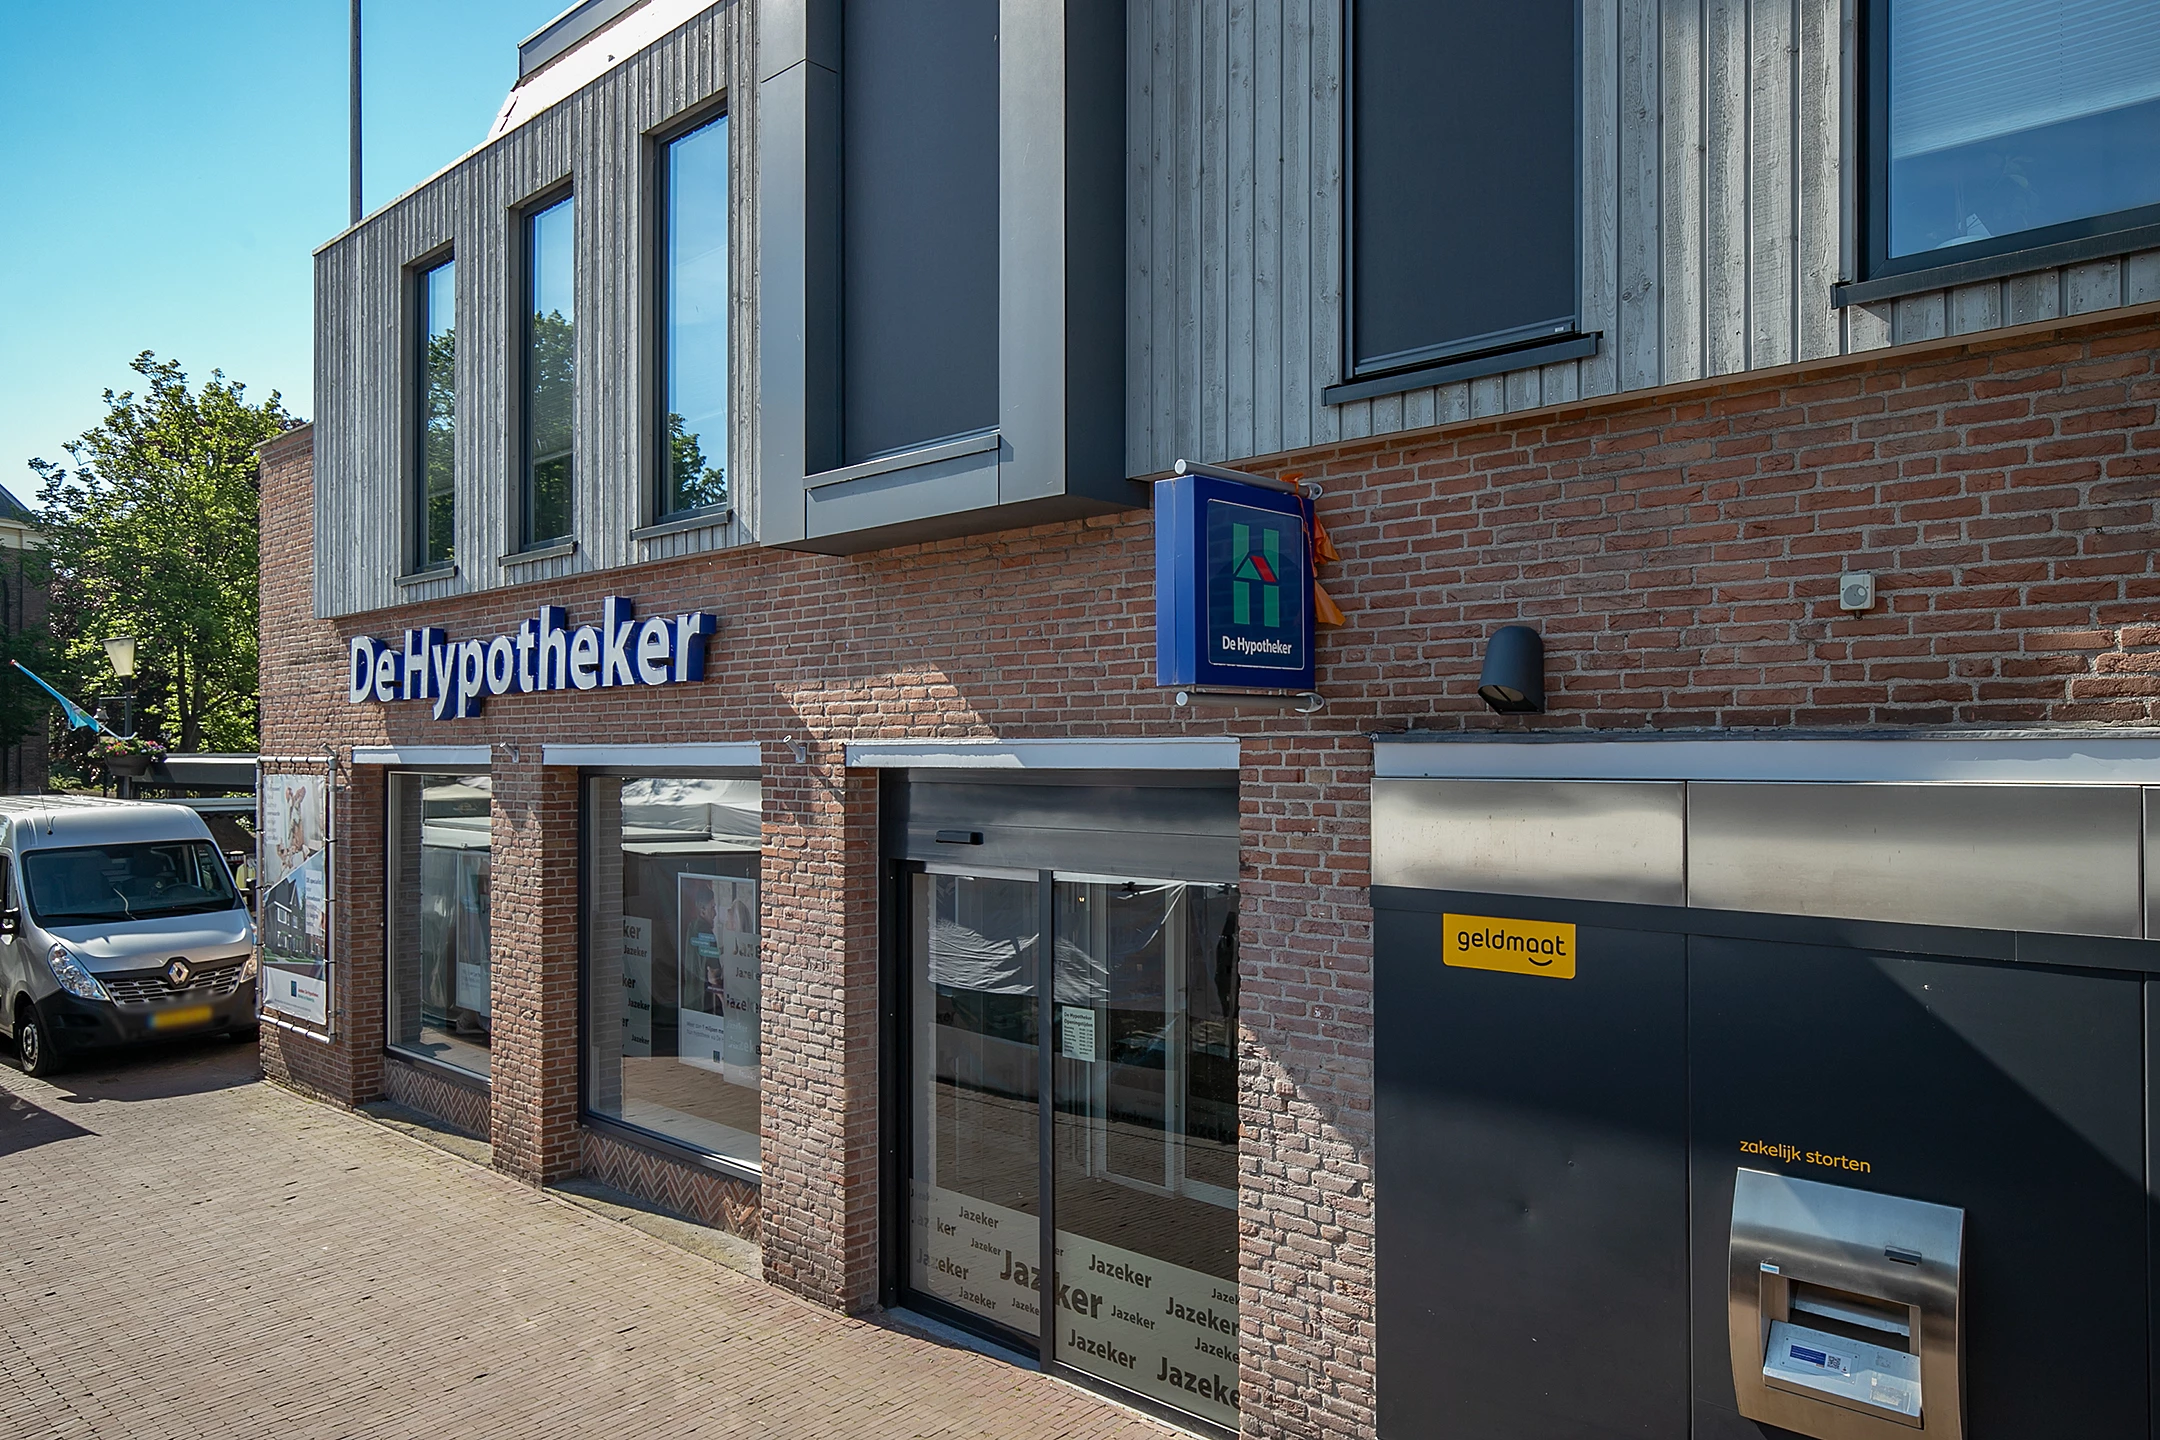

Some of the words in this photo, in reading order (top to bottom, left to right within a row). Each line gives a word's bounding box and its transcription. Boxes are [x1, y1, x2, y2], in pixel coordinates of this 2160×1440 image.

[1222, 635, 1236, 650] De
[1237, 636, 1292, 656] Hypotheker
[350, 635, 398, 703] De
[403, 595, 710, 720] Hypotheker
[623, 945, 648, 958] Jazeker
[1457, 927, 1567, 956] geldmaat
[627, 998, 650, 1011] Jazeker
[631, 1034, 650, 1045] Jazeker
[1740, 1139, 1801, 1163] zakelijk
[1806, 1150, 1871, 1173] storten
[958, 1206, 999, 1229] Jazeker
[970, 1237, 1002, 1257] Jazeker
[1088, 1254, 1152, 1289] Jazeker
[958, 1286, 997, 1310] Jazeker
[1011, 1297, 1040, 1316] Jazeke
[1110, 1304, 1156, 1331] Jazeker
[1067, 1328, 1137, 1370] Jazeker
